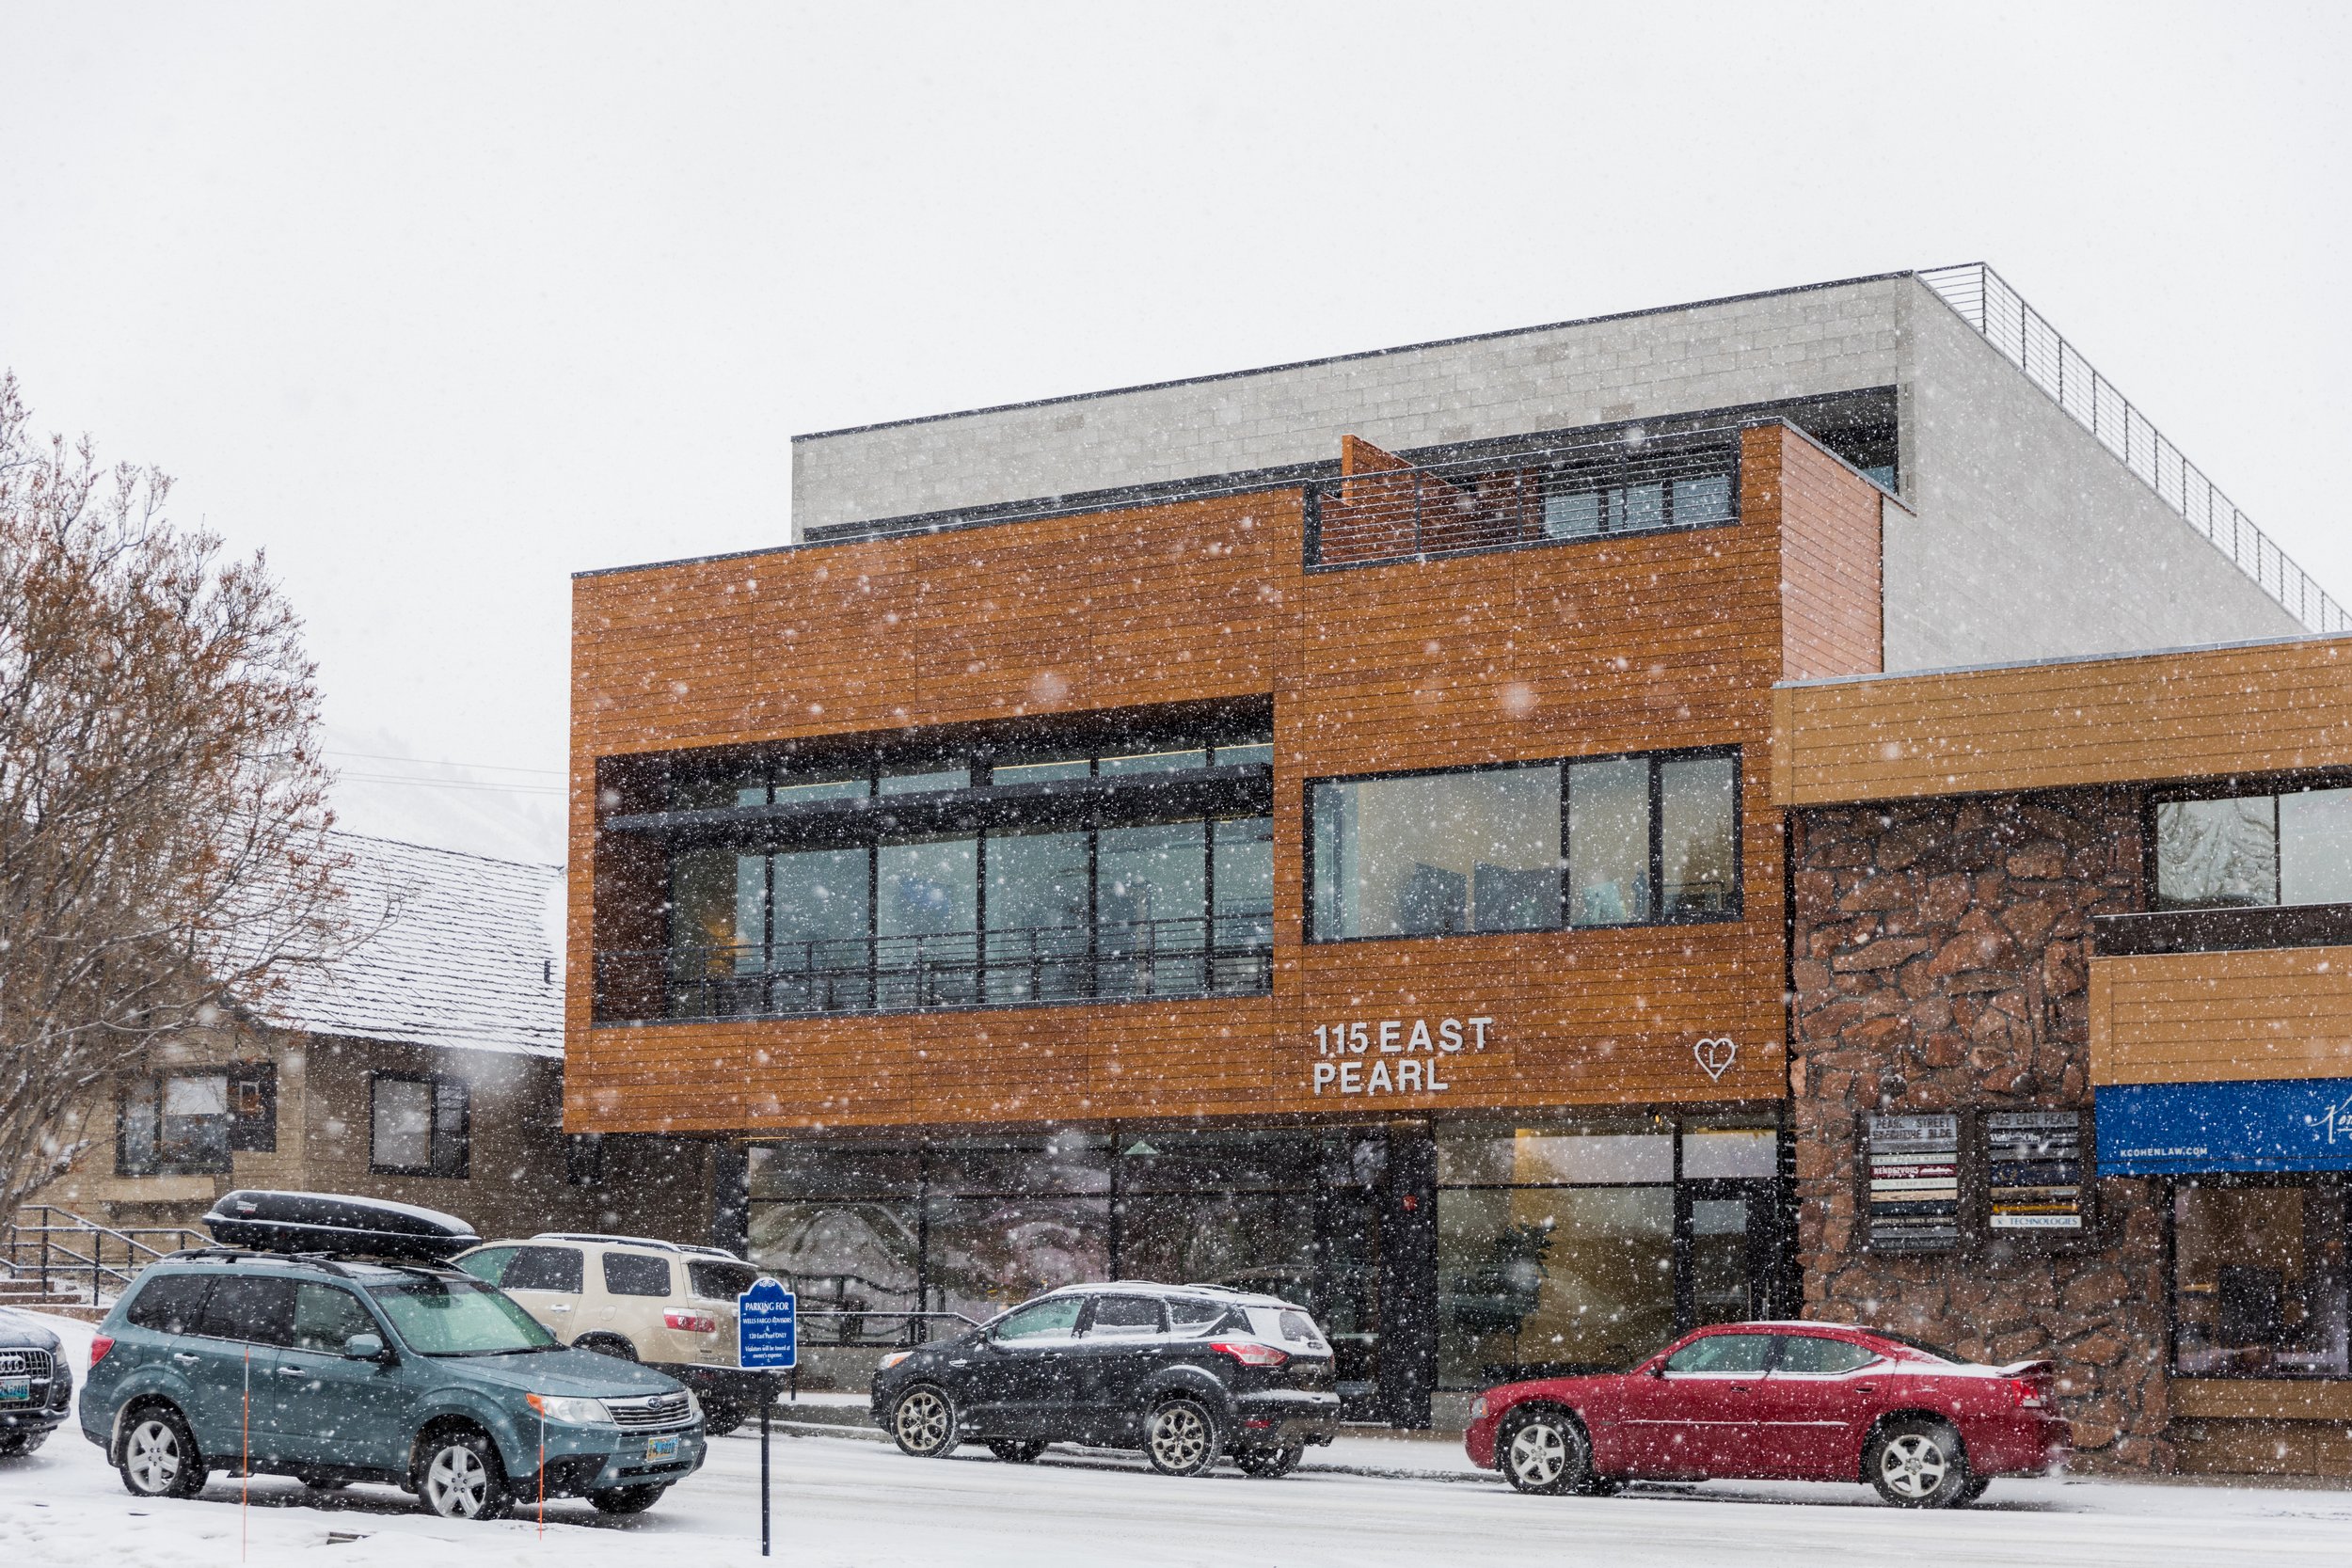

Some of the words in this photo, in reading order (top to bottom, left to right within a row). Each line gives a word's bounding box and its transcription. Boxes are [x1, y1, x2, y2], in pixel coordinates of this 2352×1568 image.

[1313, 1022, 1369, 1054] 115
[1380, 1017, 1493, 1053] EAST
[1313, 1058, 1449, 1096] PEARL
[1877, 1119, 1905, 1129] PEARL
[1916, 1117, 1950, 1128] STREET
[2017, 1115, 2038, 1125] EAST
[2044, 1114, 2075, 1125] PEARL
[2120, 1147, 2208, 1158] KCOHENLAW.COM
[1873, 1166, 1919, 1175] RENDEZVOUS
[2010, 1217, 2078, 1226] TECHNOLOGIES
[745, 1302, 774, 1311] PARKING
[775, 1302, 789, 1310] FOR
